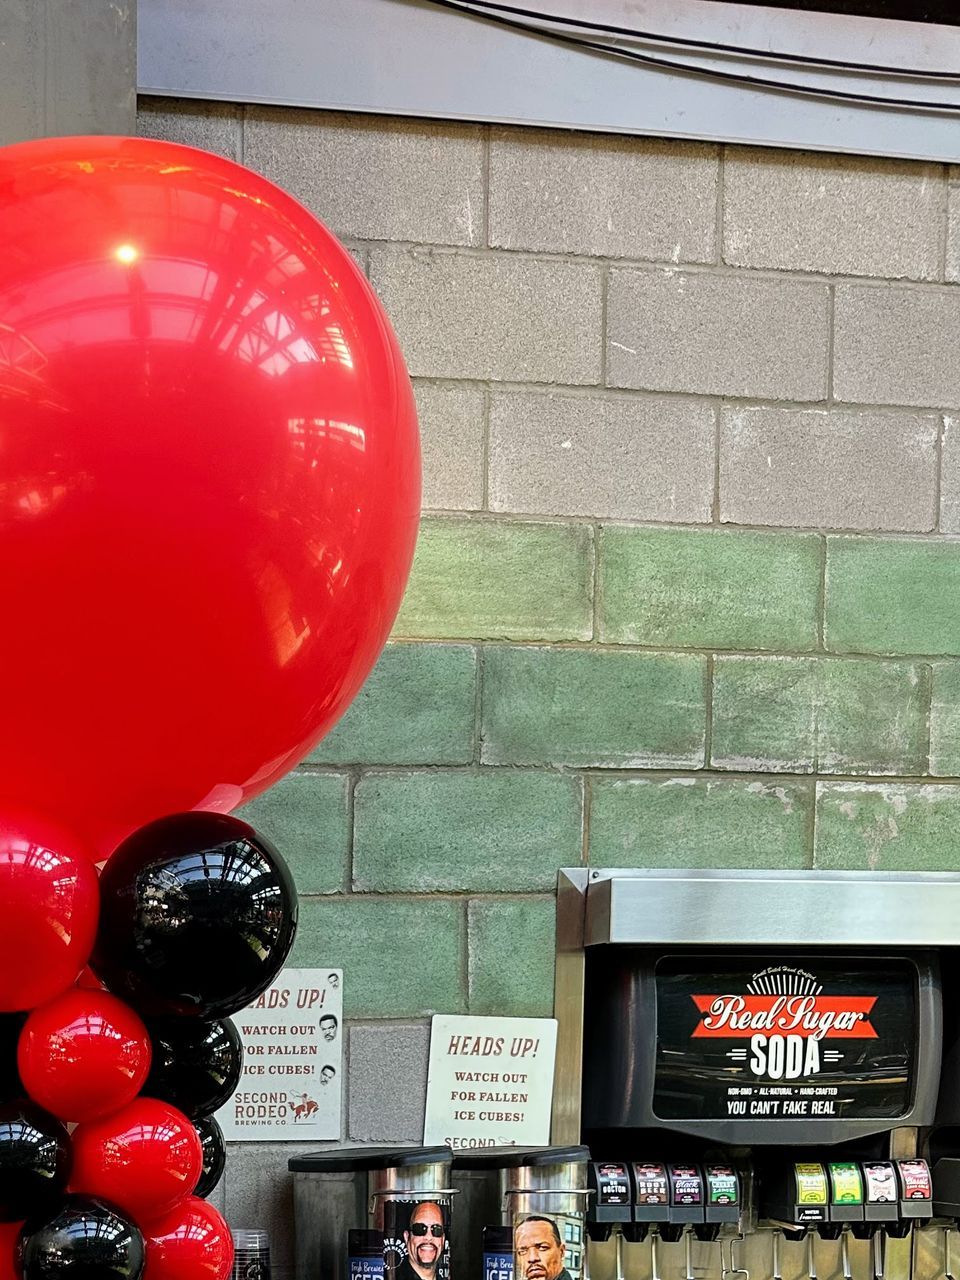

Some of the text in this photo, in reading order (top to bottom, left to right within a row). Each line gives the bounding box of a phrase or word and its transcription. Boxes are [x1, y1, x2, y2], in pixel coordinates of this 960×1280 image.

[248, 989, 327, 1009] ADS UP!
[703, 994, 864, 1041] Real Sugar
[242, 1025, 316, 1036] WATCH OUT
[268, 1045, 318, 1055] FALLEN
[447, 1035, 540, 1058] HEADS UP!
[749, 1033, 821, 1079] SODA
[243, 1064, 315, 1075] ICE CUBES!
[454, 1072, 528, 1083] WATCH OUT
[235, 1092, 287, 1104] SECOND
[451, 1091, 529, 1103] FOR FALLEN
[235, 1105, 287, 1119] RODEO
[727, 1101, 836, 1115] YOU CAN'T FAKE REAL
[454, 1110, 525, 1122] ICE CUBES!
[444, 1137, 496, 1149] SECOND
